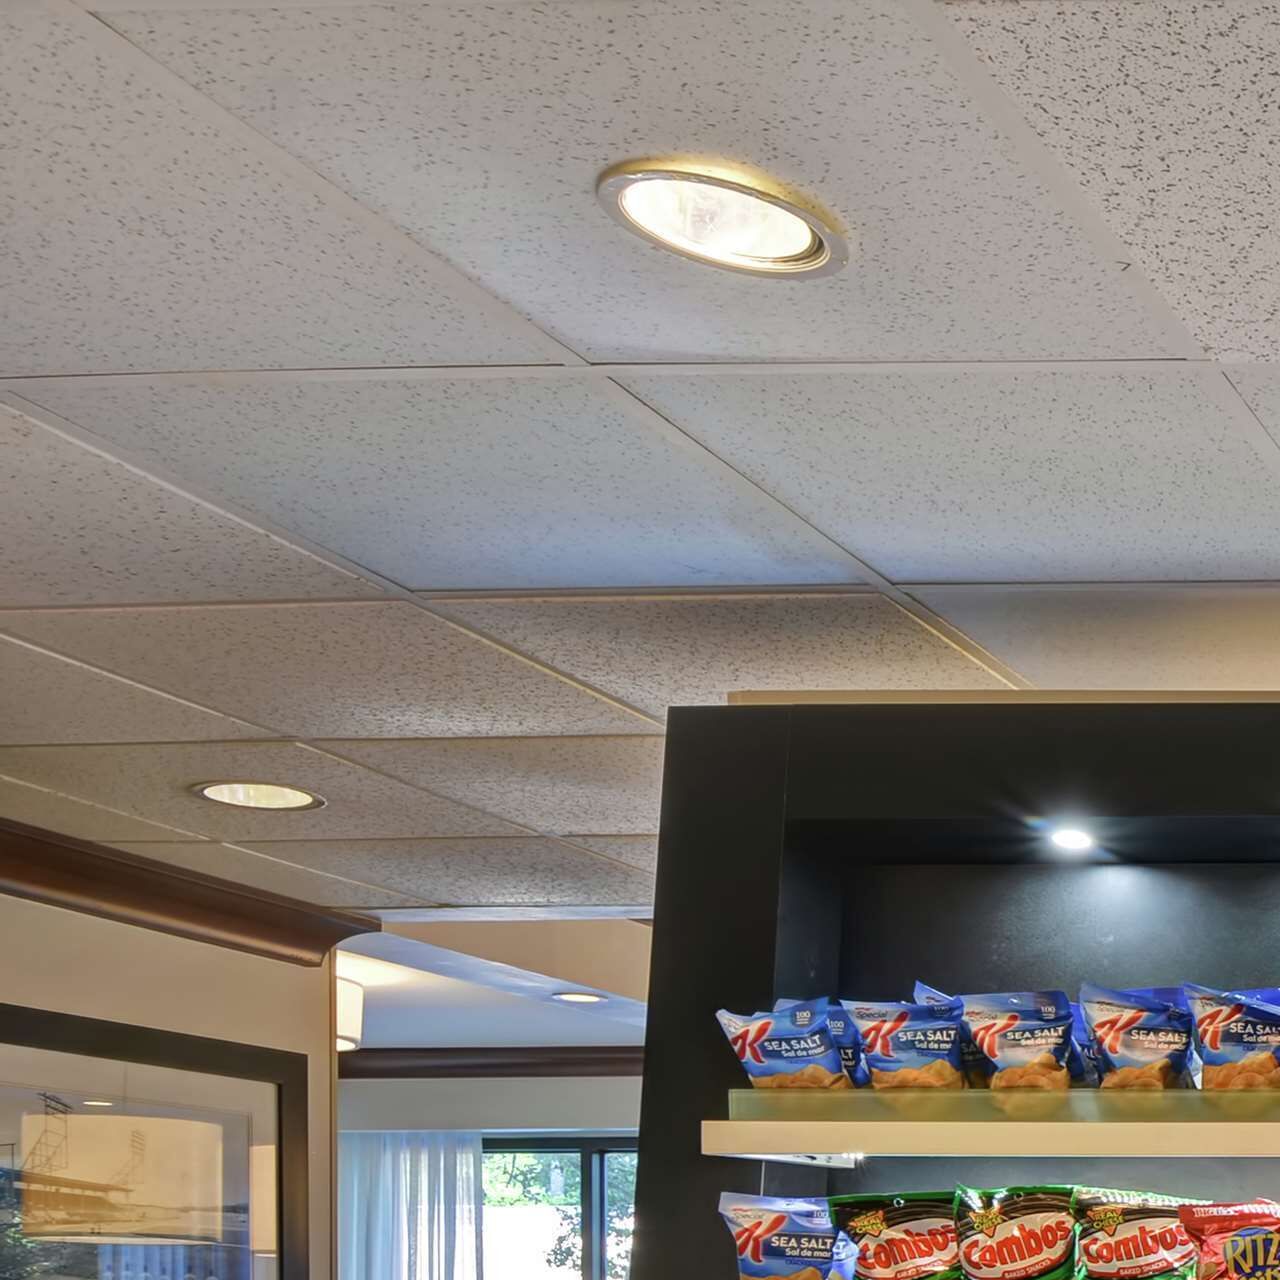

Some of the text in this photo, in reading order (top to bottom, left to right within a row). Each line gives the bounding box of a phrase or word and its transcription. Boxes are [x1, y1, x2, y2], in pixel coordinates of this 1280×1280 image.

[763, 1034, 821, 1051] SEA SALT
[861, 1011, 909, 1057] K
[899, 1029, 956, 1042] SEA SALT
[972, 1013, 1020, 1059] K
[1006, 1026, 1064, 1040] SEA SALT
[1095, 1009, 1147, 1054] K
[1130, 1029, 1188, 1044] SEA SALT
[1229, 1022, 1253, 1035] SEA
[735, 1213, 788, 1264] K
[771, 1235, 834, 1250] SEA SALT
[855, 1224, 957, 1270] Combos
[962, 1220, 1072, 1271] Combos
[1082, 1222, 1188, 1265] Combos
